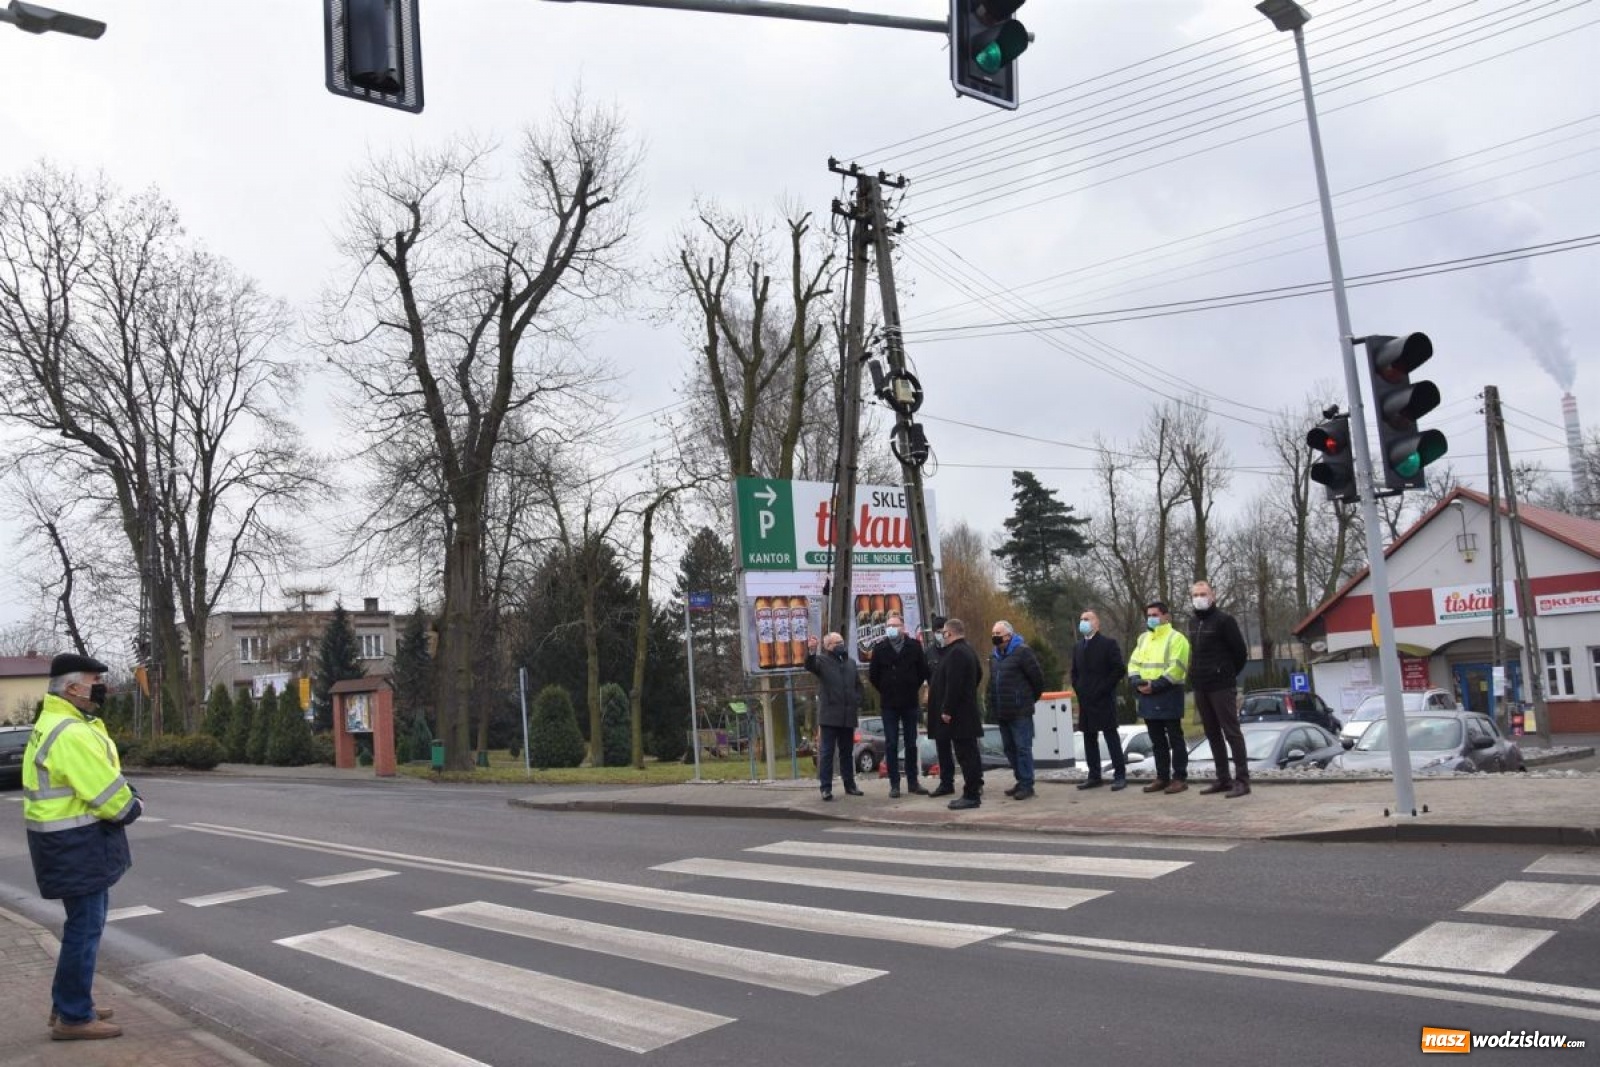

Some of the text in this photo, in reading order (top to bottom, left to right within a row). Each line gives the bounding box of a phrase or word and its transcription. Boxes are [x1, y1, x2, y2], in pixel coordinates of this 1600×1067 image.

[872, 491, 906, 509] SKLE
[759, 511, 776, 539] P
[749, 553, 790, 564] KANTOR
[873, 554, 901, 563] NISKIE
[1295, 675, 1305, 690] P
